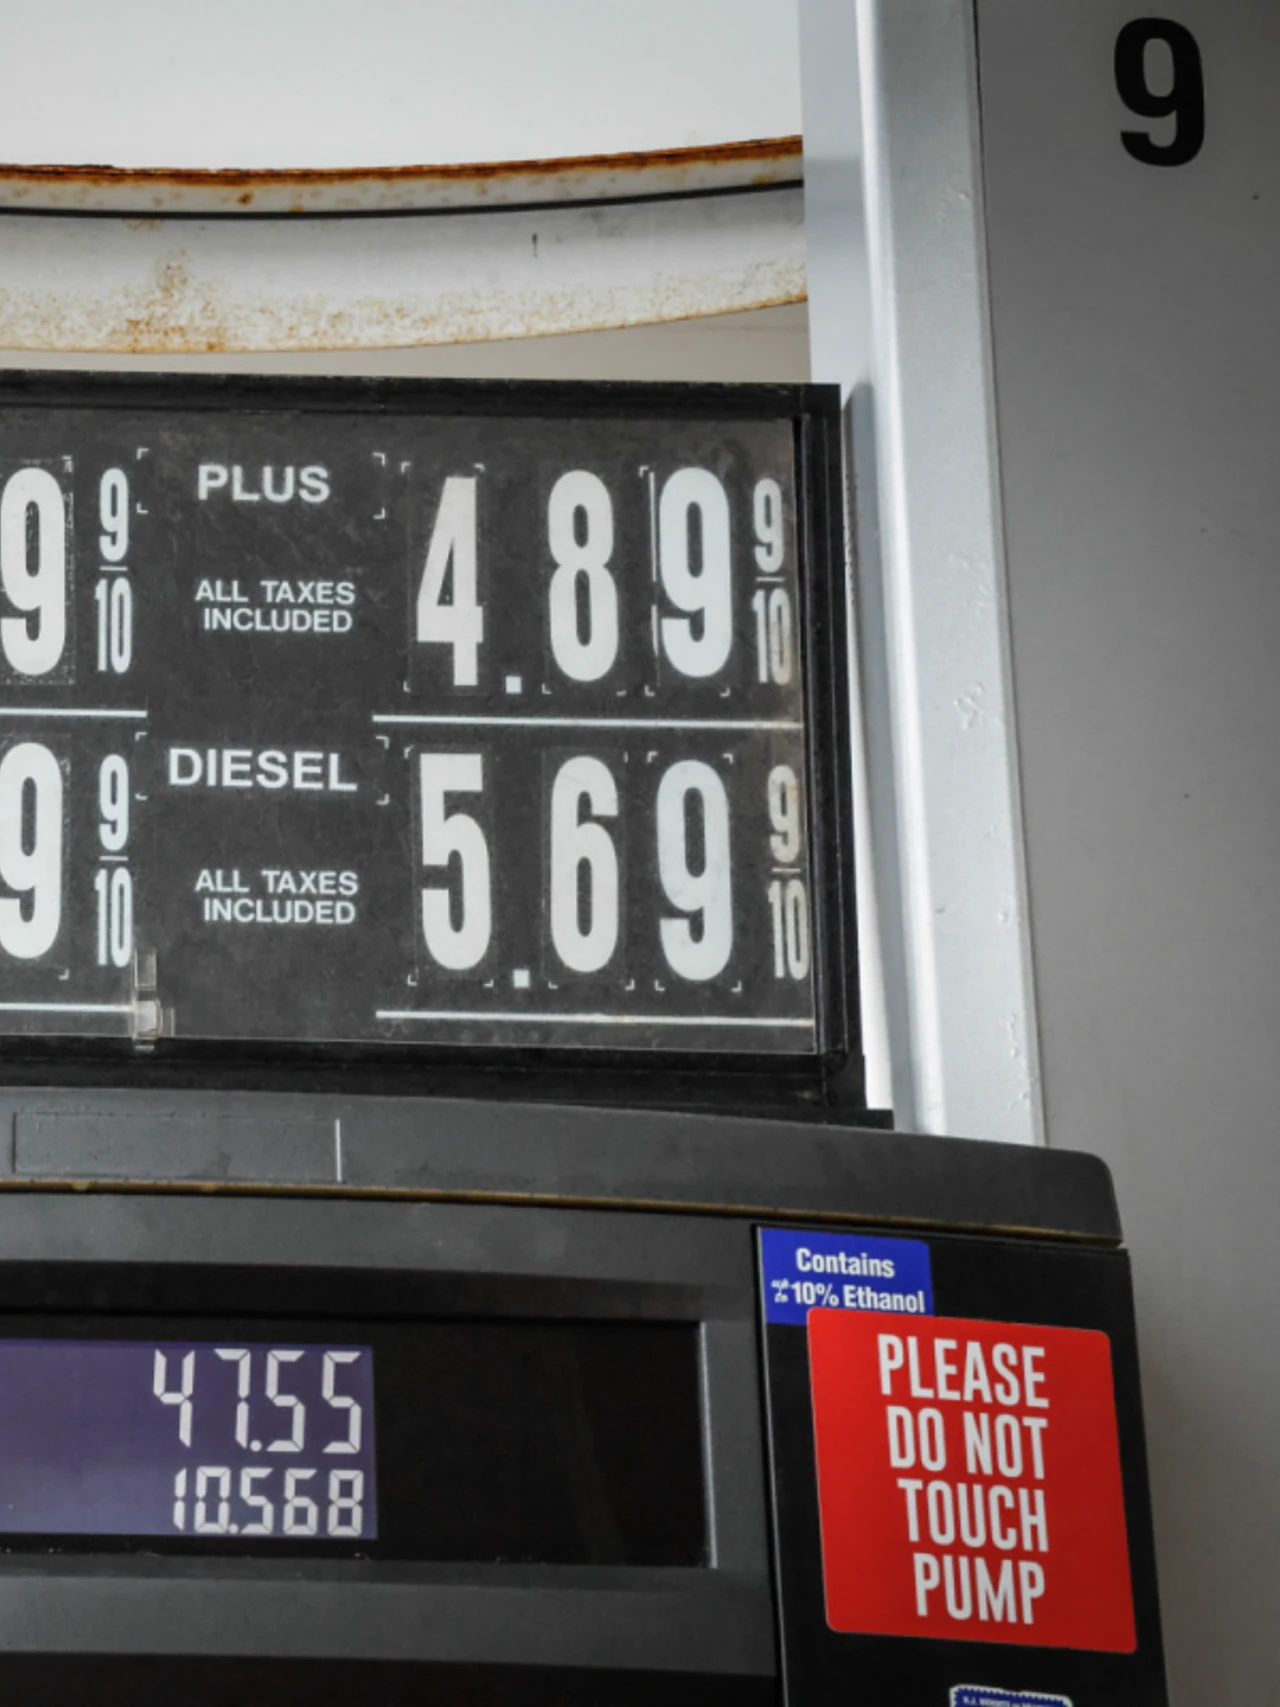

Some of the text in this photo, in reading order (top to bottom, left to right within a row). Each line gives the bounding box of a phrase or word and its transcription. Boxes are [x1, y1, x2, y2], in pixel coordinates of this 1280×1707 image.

[1114, 17, 1205, 167] 9
[197, 464, 331, 503] PLUS
[195, 579, 356, 605] ALL TAXES
[417, 467, 733, 694] 4.89
[203, 608, 352, 633] INCLUDED
[169, 747, 358, 791] DIESEL
[195, 869, 359, 896] ALL TAXES
[420, 753, 734, 988] 5.69
[203, 898, 356, 924] INCLUDED
[790, 1281, 840, 1307] 10%
[843, 1284, 926, 1313] Ethanol
[795, 1247, 896, 1279] Contains
[152, 1348, 362, 1454] 47.55
[877, 1333, 1049, 1408] PLEASE
[886, 1405, 1049, 1480] DO NOT
[174, 1466, 364, 1536] 10.568
[897, 1477, 1049, 1552] TOUCH
[913, 1552, 1046, 1625] PUMP
